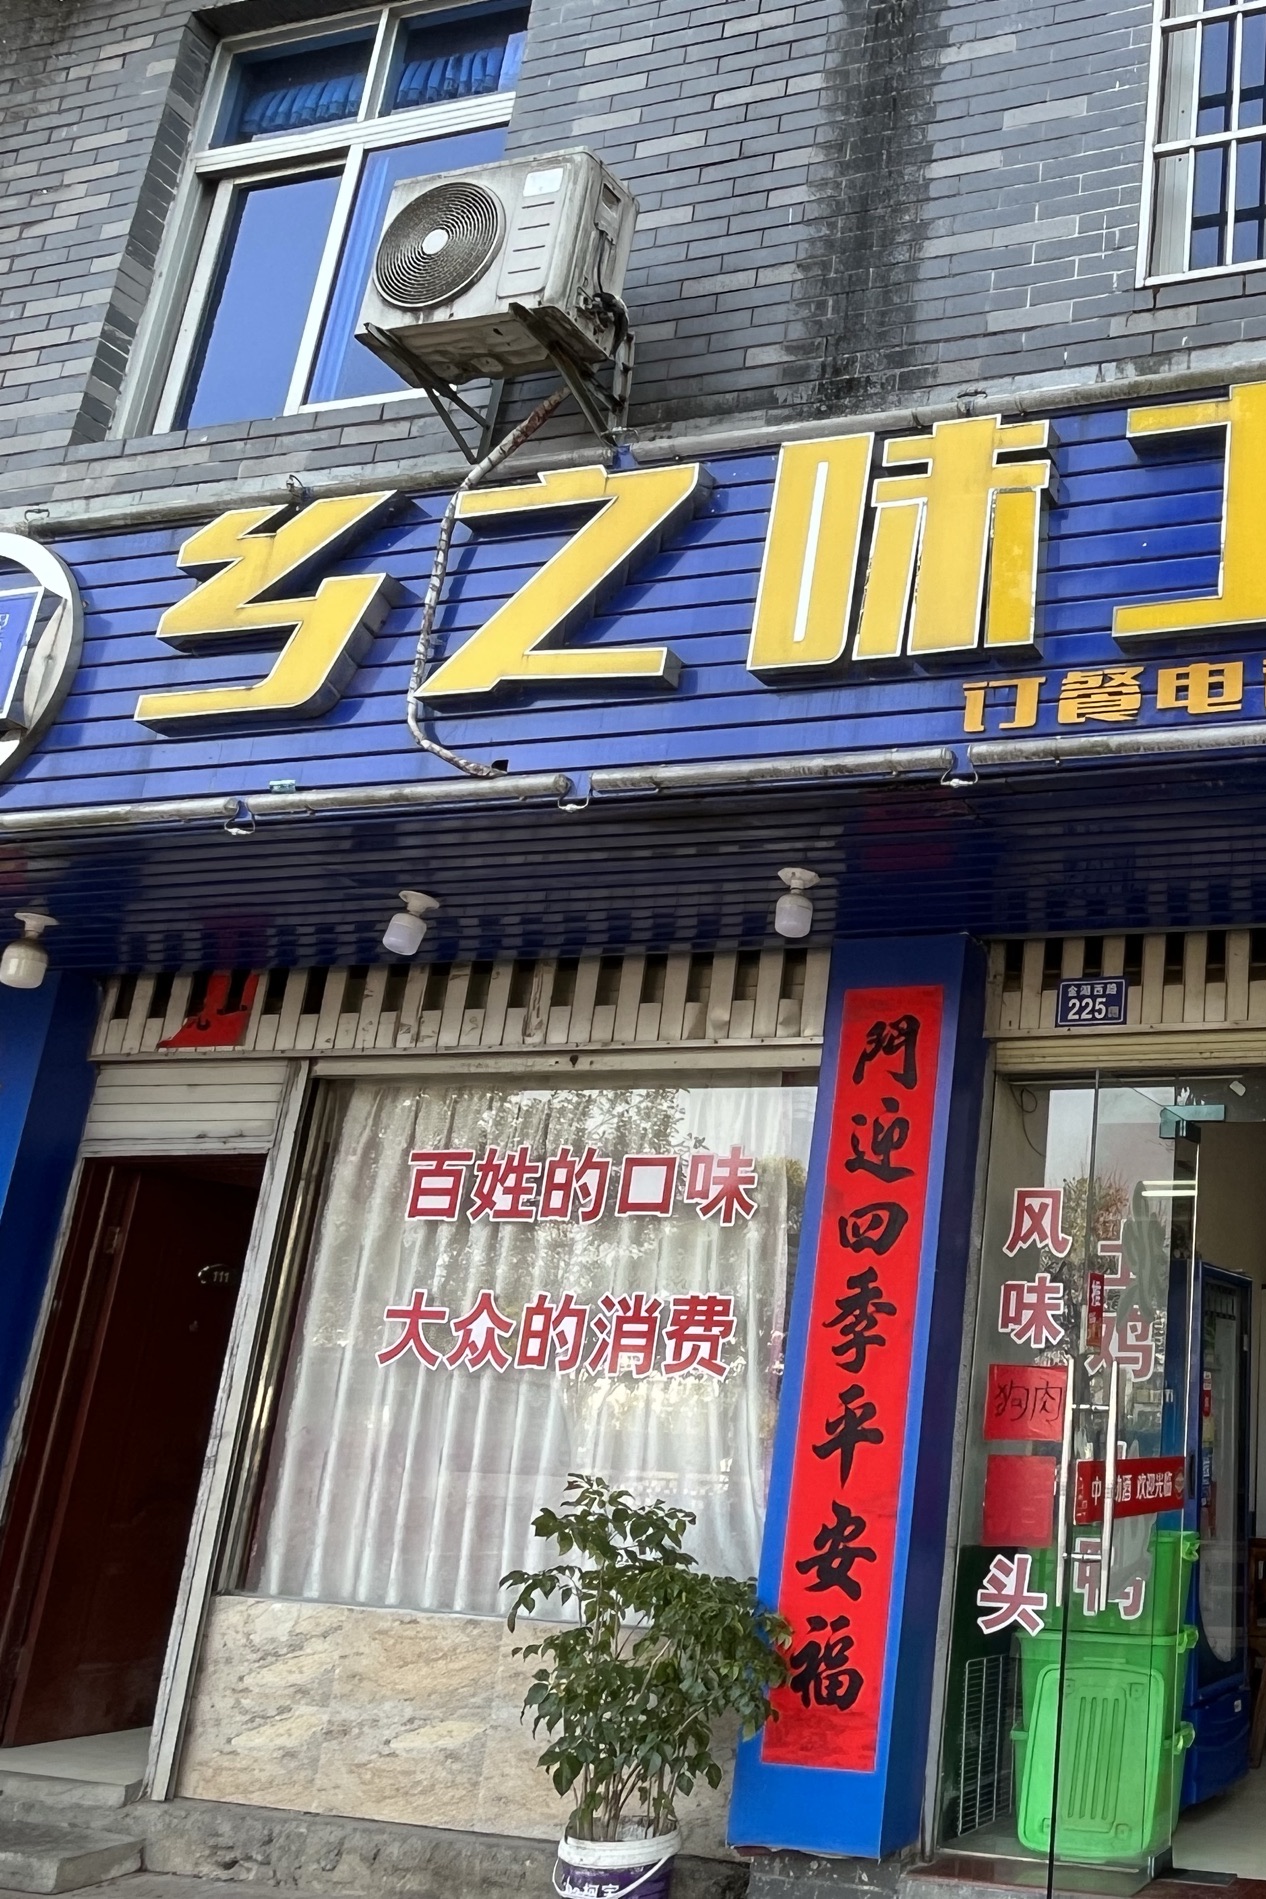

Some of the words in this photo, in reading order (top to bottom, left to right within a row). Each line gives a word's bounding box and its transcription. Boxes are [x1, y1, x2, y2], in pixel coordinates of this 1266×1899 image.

[406, 1145, 758, 1227] 百姓的口味
[376, 1289, 738, 1381] 大众的消费
[995, 1377, 1064, 1425] 狗肉
